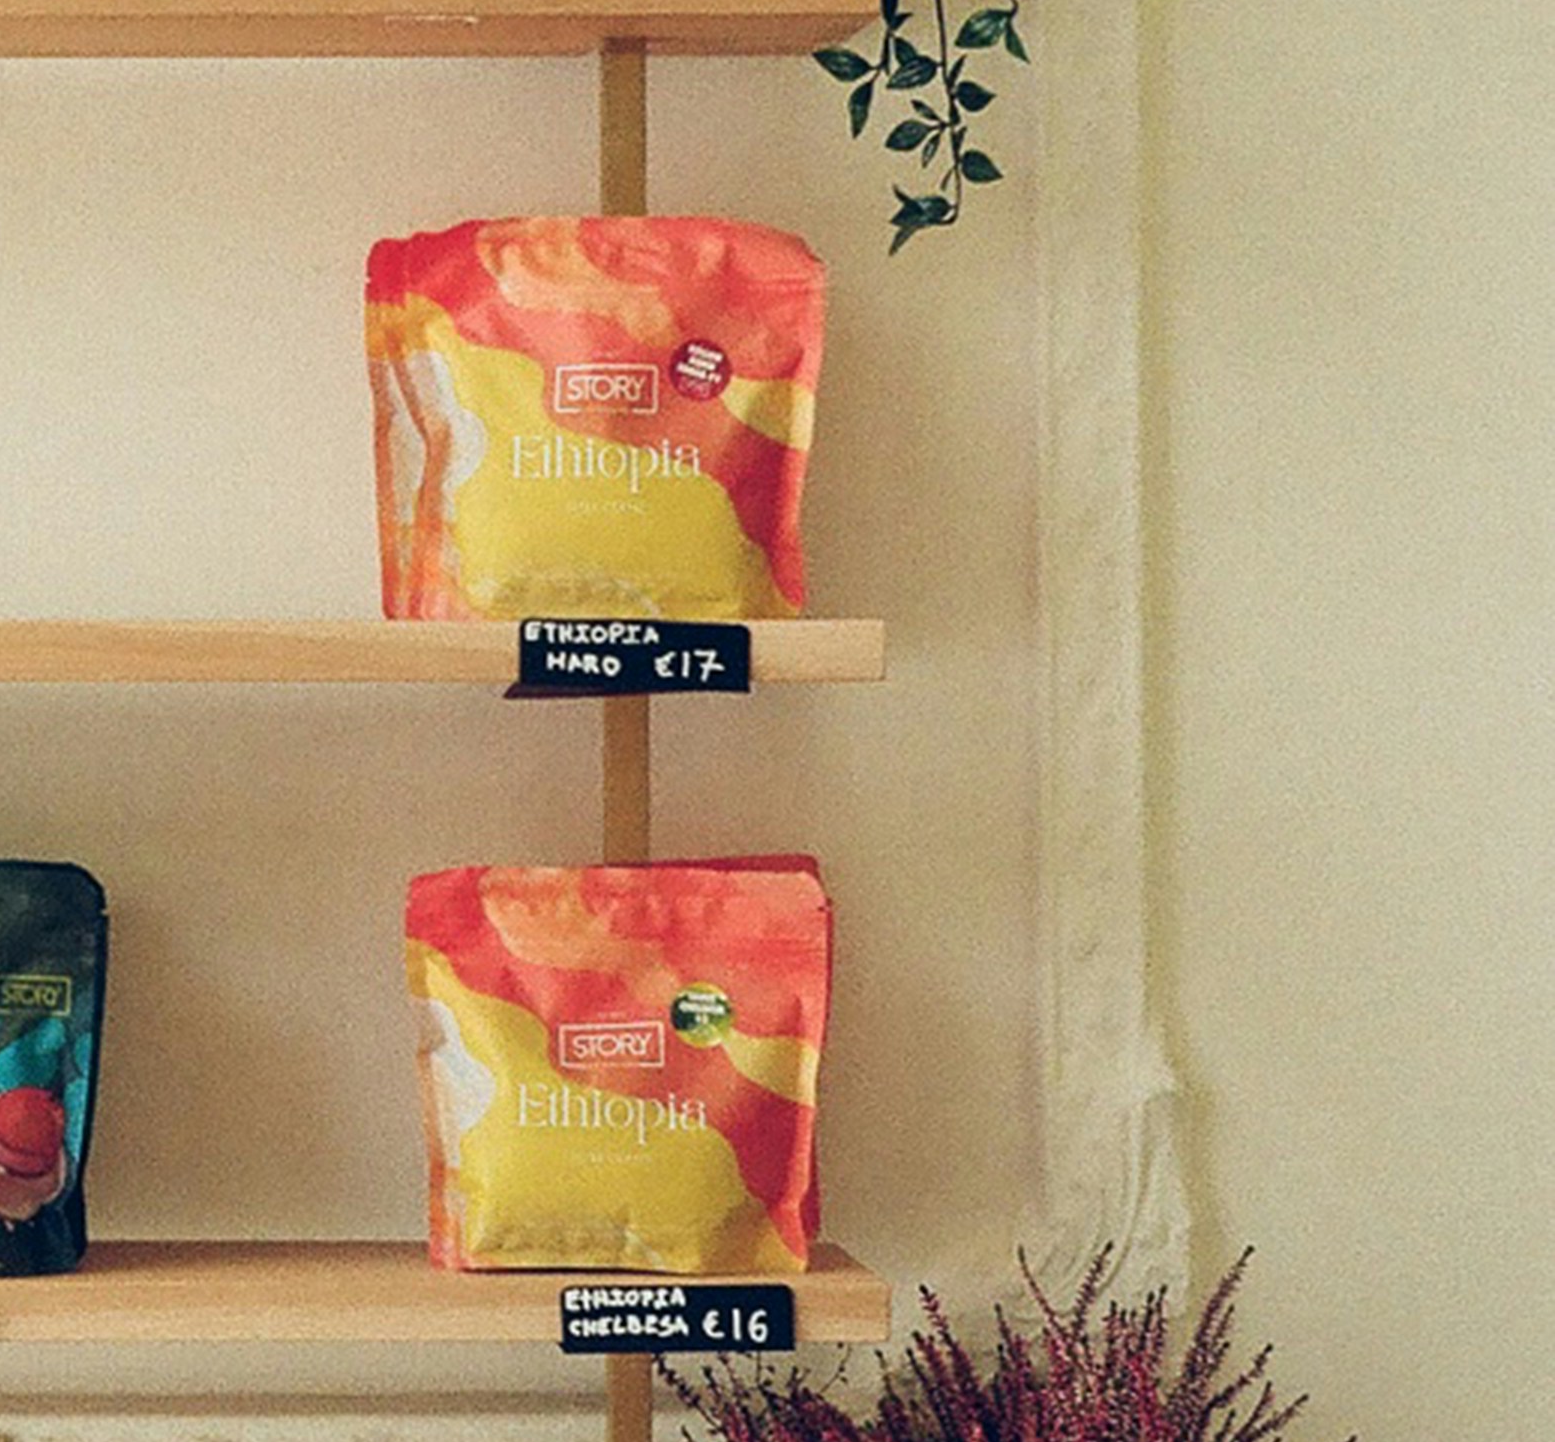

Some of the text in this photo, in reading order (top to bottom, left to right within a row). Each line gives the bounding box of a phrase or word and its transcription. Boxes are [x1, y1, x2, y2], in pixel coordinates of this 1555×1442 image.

[566, 374, 646, 402] STORY
[512, 434, 702, 495] Ethiopia
[523, 621, 660, 645] ETHIOPIA
[546, 648, 725, 683] HARO €17
[572, 1032, 653, 1059] STORY
[518, 1082, 709, 1146] Ethiopia
[701, 1307, 769, 1343] €16
